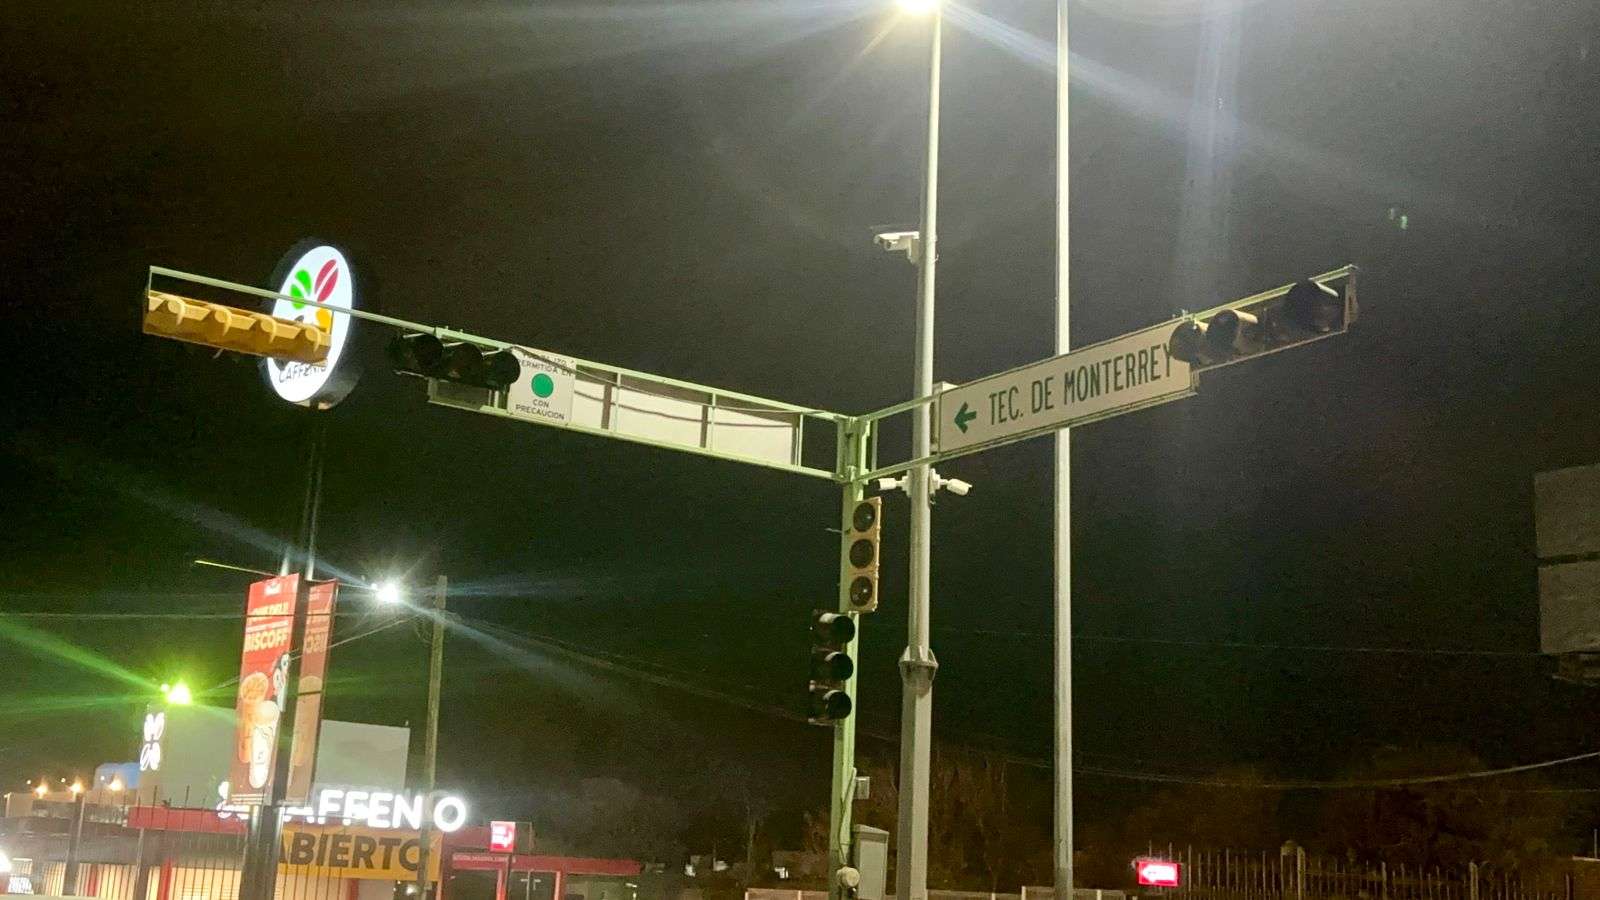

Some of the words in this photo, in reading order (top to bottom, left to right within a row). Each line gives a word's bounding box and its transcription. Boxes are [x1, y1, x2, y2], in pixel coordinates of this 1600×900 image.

[532, 398, 550, 408] CON
[989, 386, 1024, 425] TEC.
[1031, 377, 1054, 414] DE
[1063, 342, 1171, 406] MONTERREY
[280, 831, 422, 871] BIERTO
